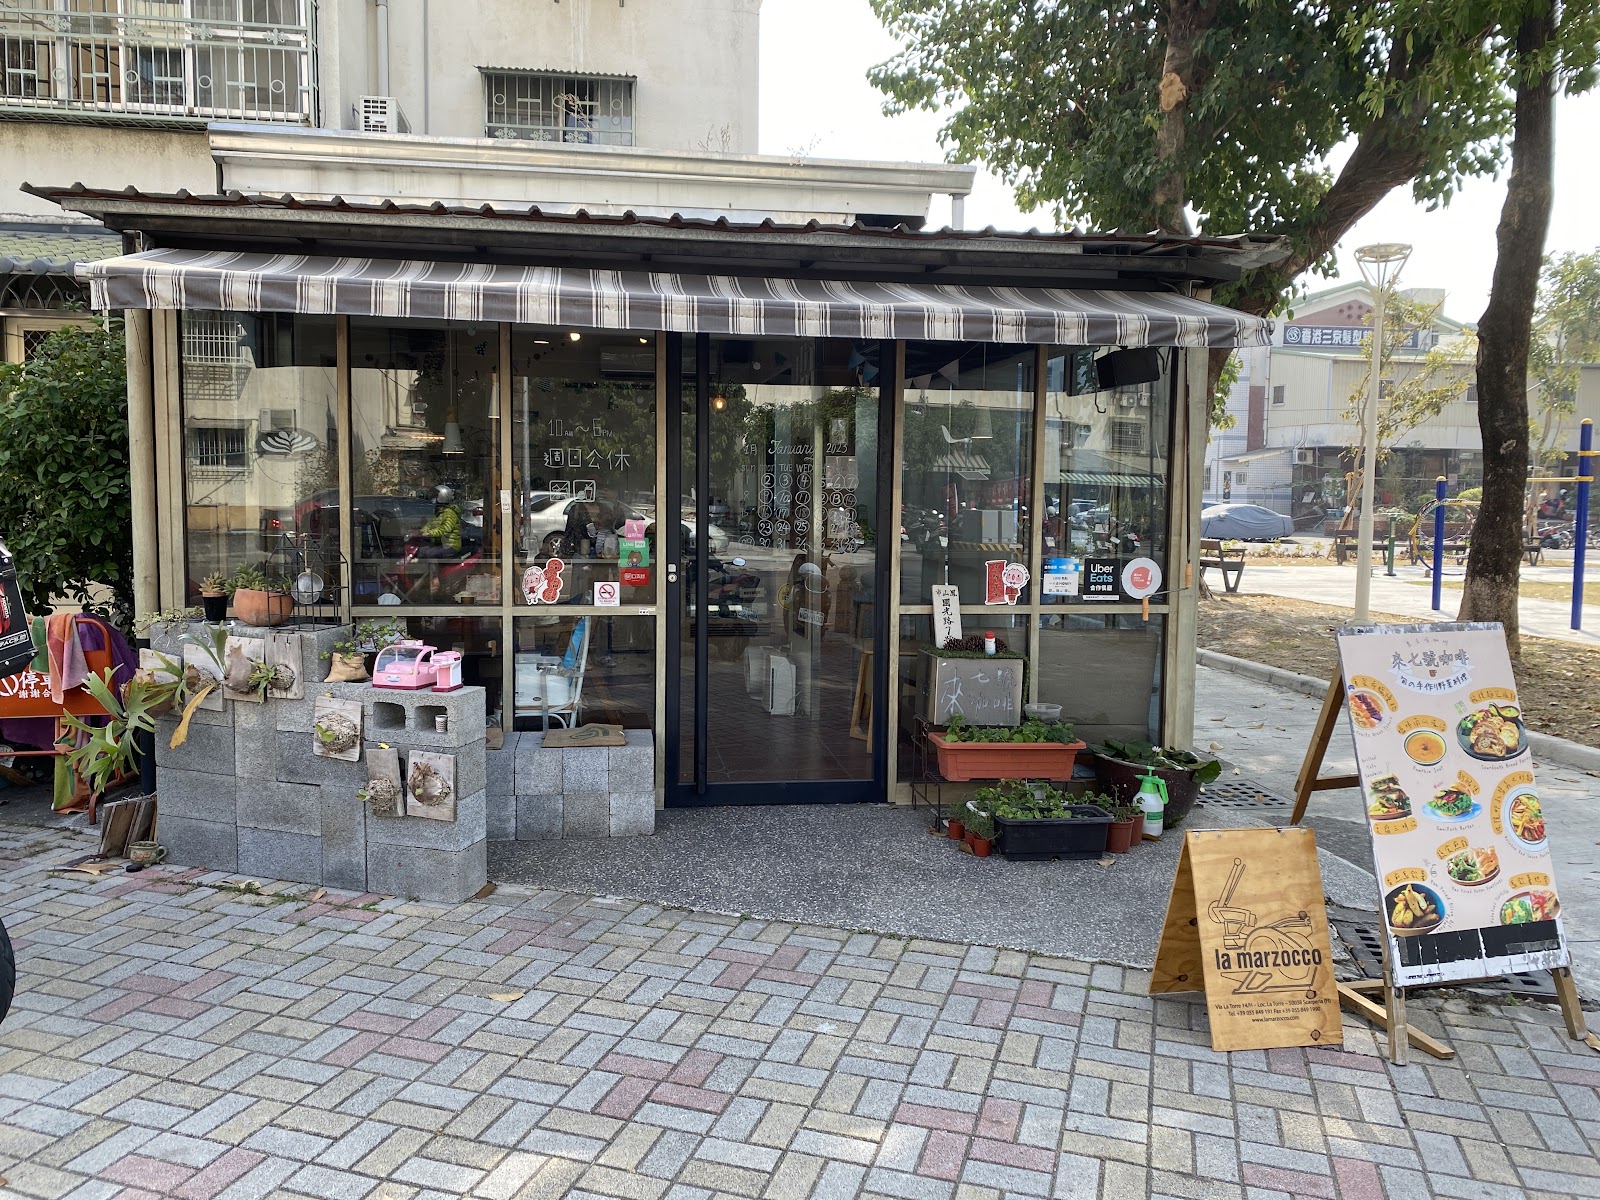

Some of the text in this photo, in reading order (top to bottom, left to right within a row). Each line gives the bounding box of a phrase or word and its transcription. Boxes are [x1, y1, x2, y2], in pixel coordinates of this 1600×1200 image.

[543, 447, 631, 471] 週日公休
[768, 439, 817, 461] January
[826, 441, 848, 454] 2023
[1089, 573, 1114, 583] Eats
[1090, 563, 1114, 573] Uber
[1214, 948, 1323, 970] la marzocco
